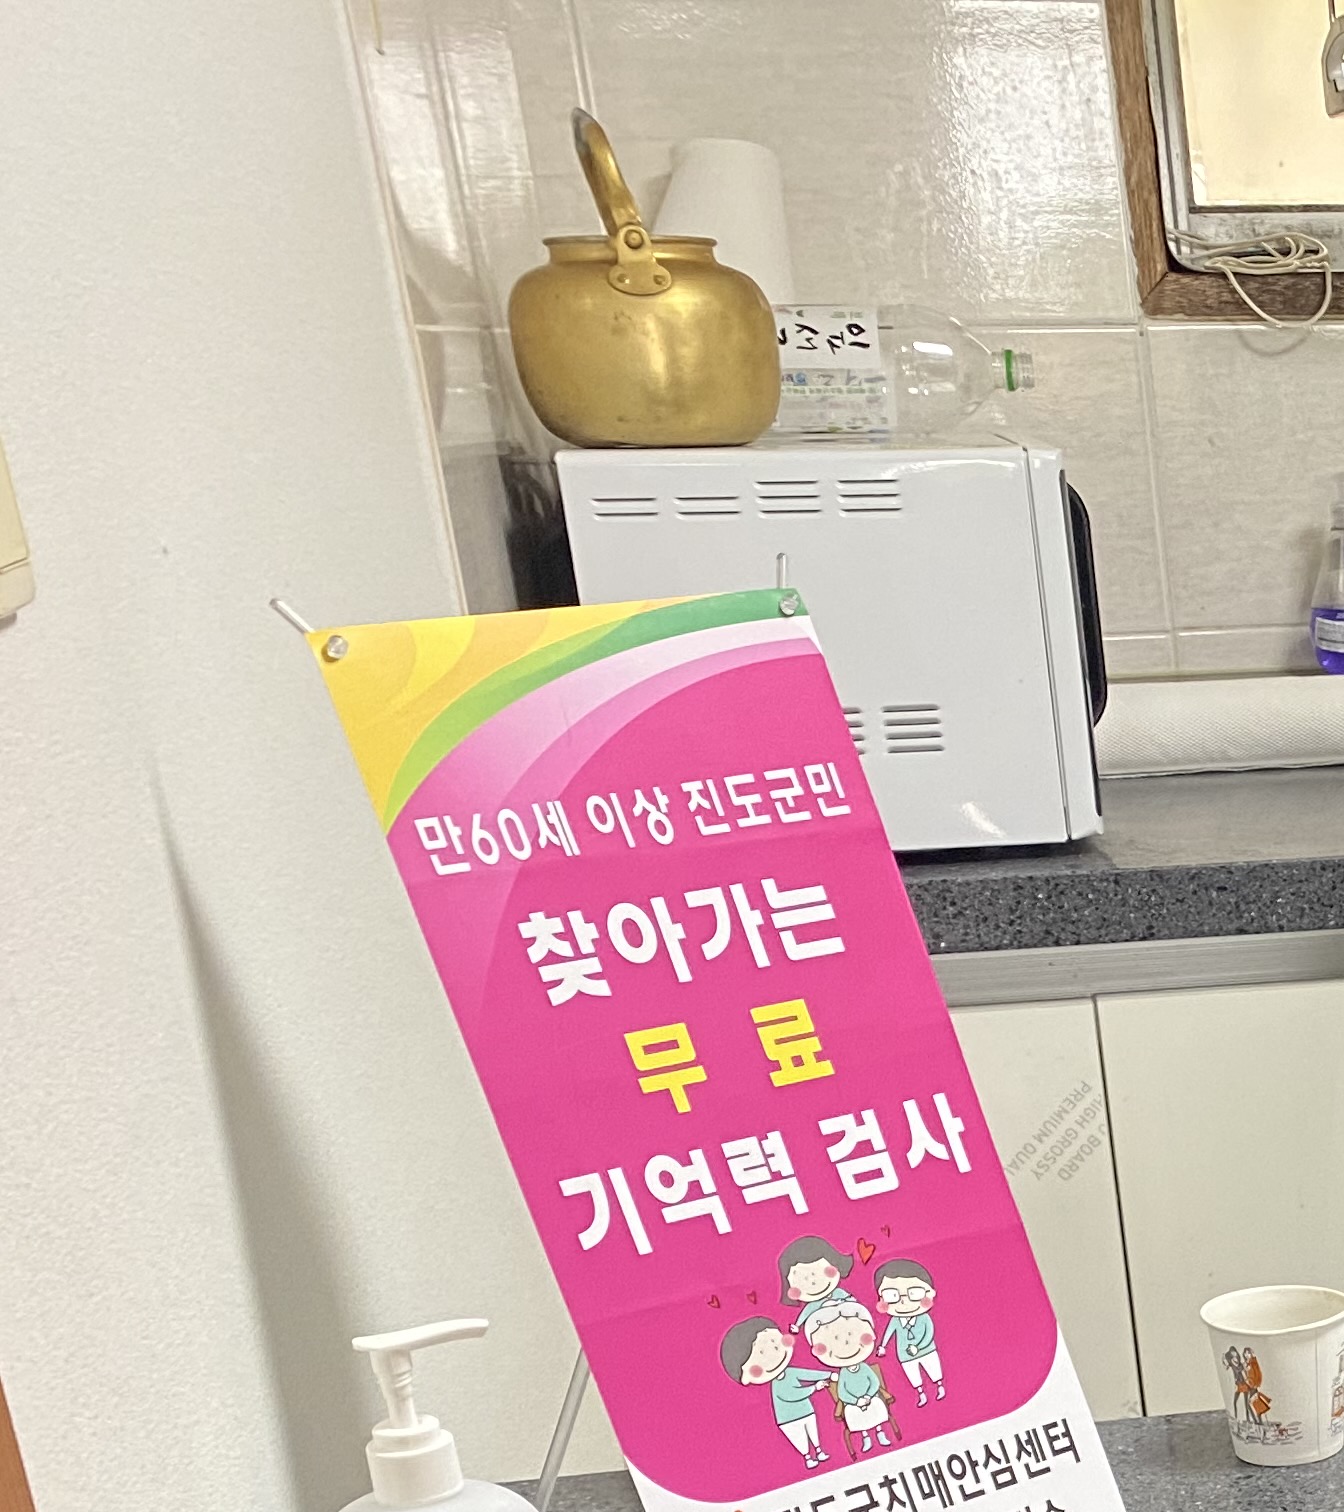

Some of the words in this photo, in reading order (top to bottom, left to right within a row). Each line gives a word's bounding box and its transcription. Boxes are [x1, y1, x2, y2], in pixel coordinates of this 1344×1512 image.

[414, 805, 580, 875] 만60세
[590, 791, 674, 848] 이상
[685, 762, 852, 836] 진도군민
[518, 877, 846, 1007] 찾아가는
[624, 1023, 708, 1113] 무
[750, 999, 836, 1087] 료
[1032, 1080, 1093, 1144] PREMIUM
[559, 1128, 808, 1255] 기억력
[819, 1092, 972, 1201] 검사
[1030, 1127, 1079, 1181] GROSSY
[1057, 1134, 1102, 1181] BOARD
